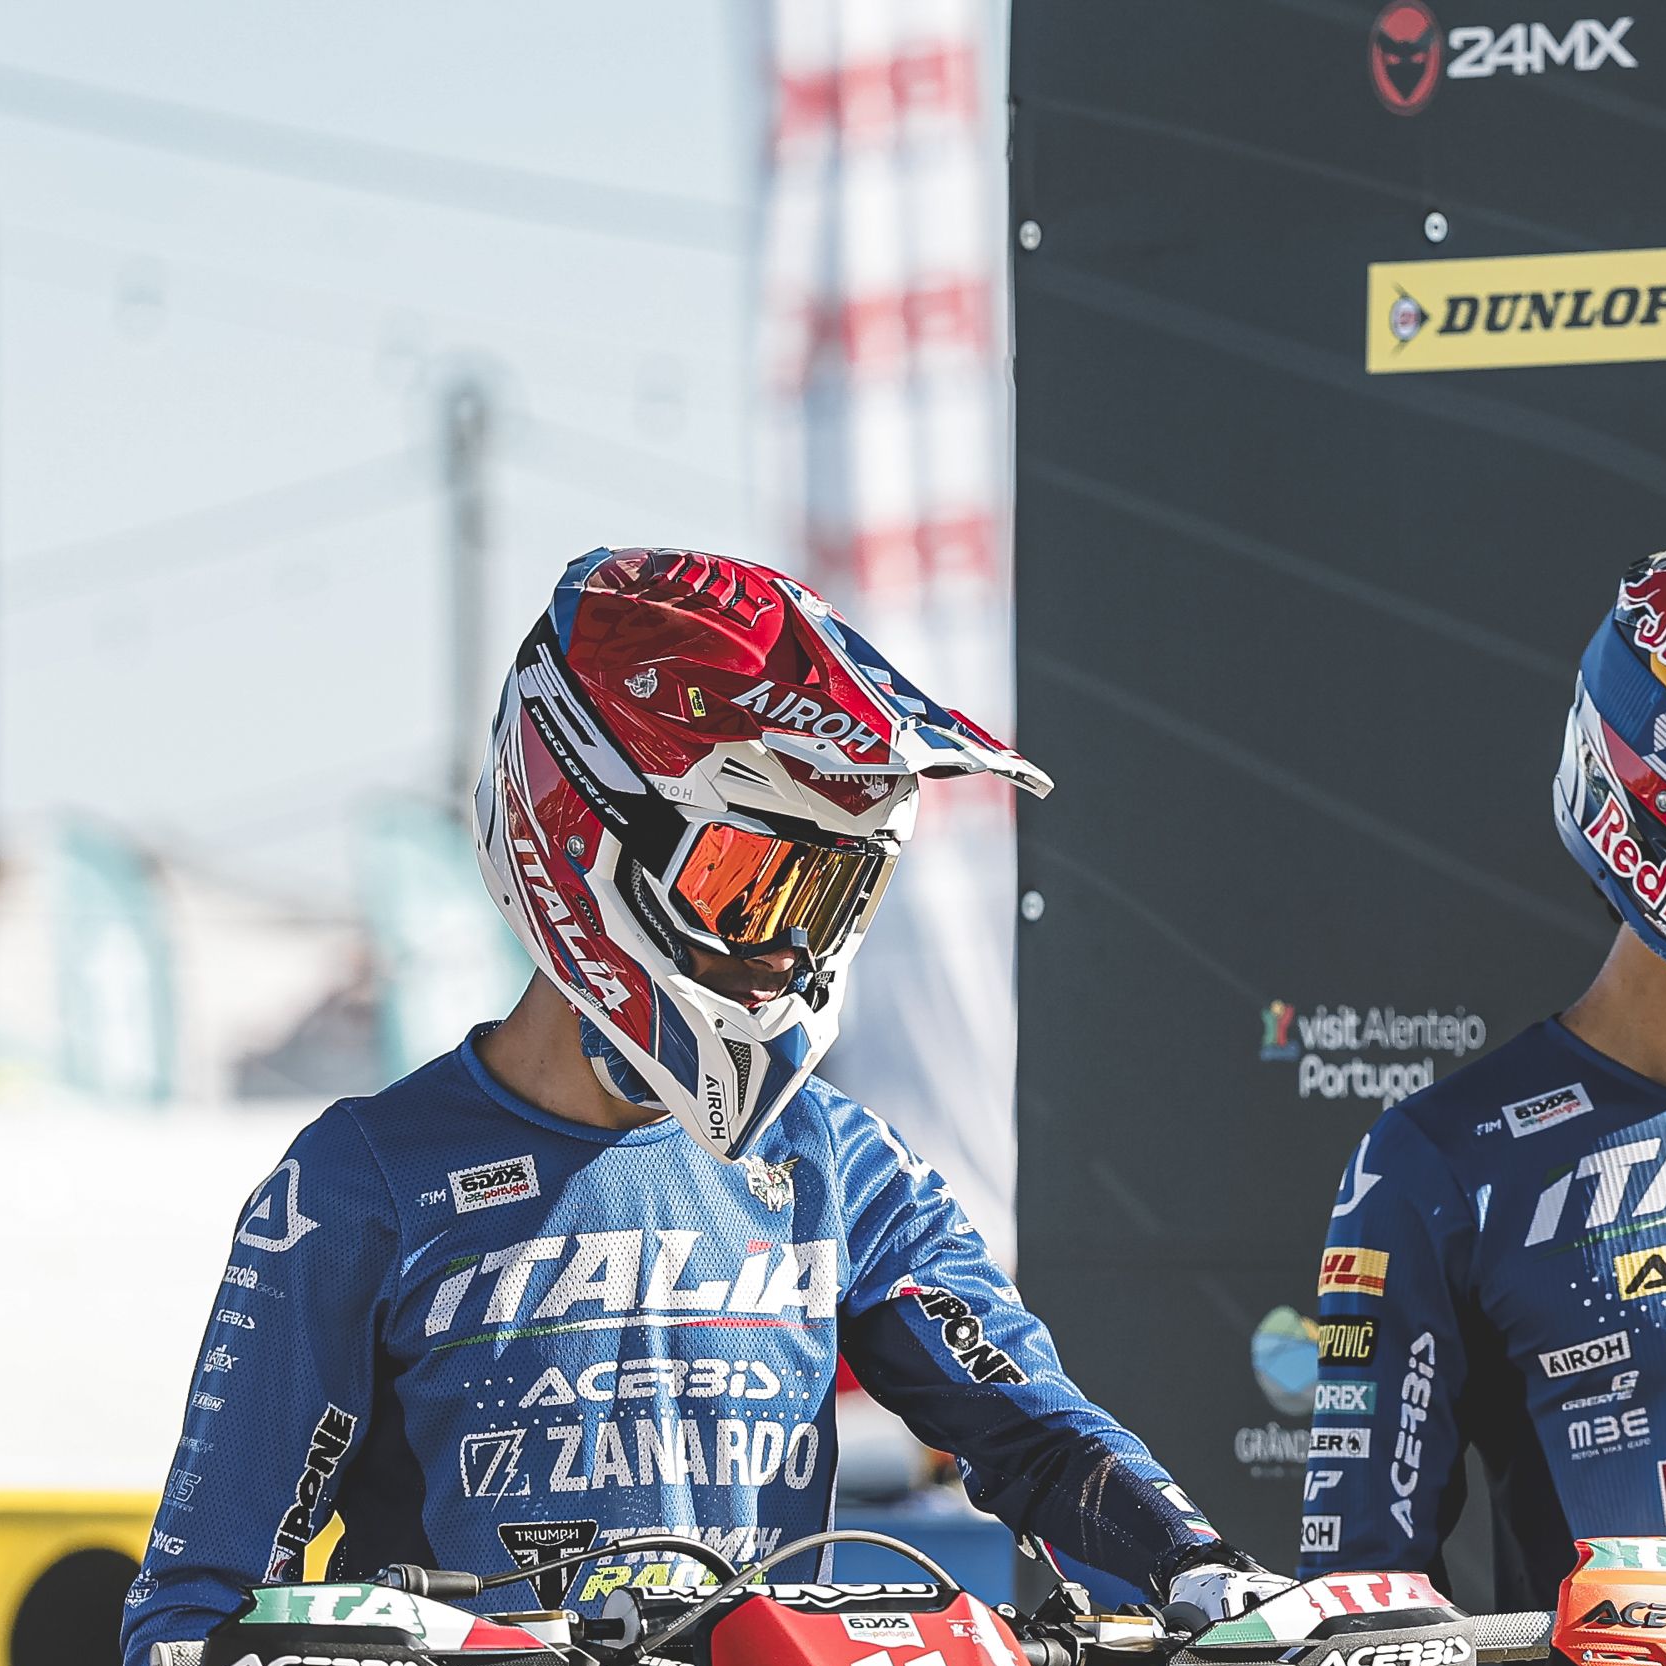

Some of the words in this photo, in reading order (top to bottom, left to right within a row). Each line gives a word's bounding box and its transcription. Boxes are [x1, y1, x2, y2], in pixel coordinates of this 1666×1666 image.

[1447, 17, 1638, 79] 24MX
[732, 680, 882, 756] AIROH
[529, 707, 630, 826] PROGRIP
[513, 837, 633, 1013] ITALIA
[1362, 1006, 1487, 1056] Alentejo
[705, 1073, 727, 1142] AIROH
[425, 1227, 842, 1338] ITALIA
[519, 1357, 782, 1408] ACERBIS
[1549, 1337, 1625, 1374] AIROH
[547, 1418, 820, 1493] ZANARDO
[515, 1526, 580, 1542] TRIUMPH
[848, 1617, 910, 1630] 6DAYS
